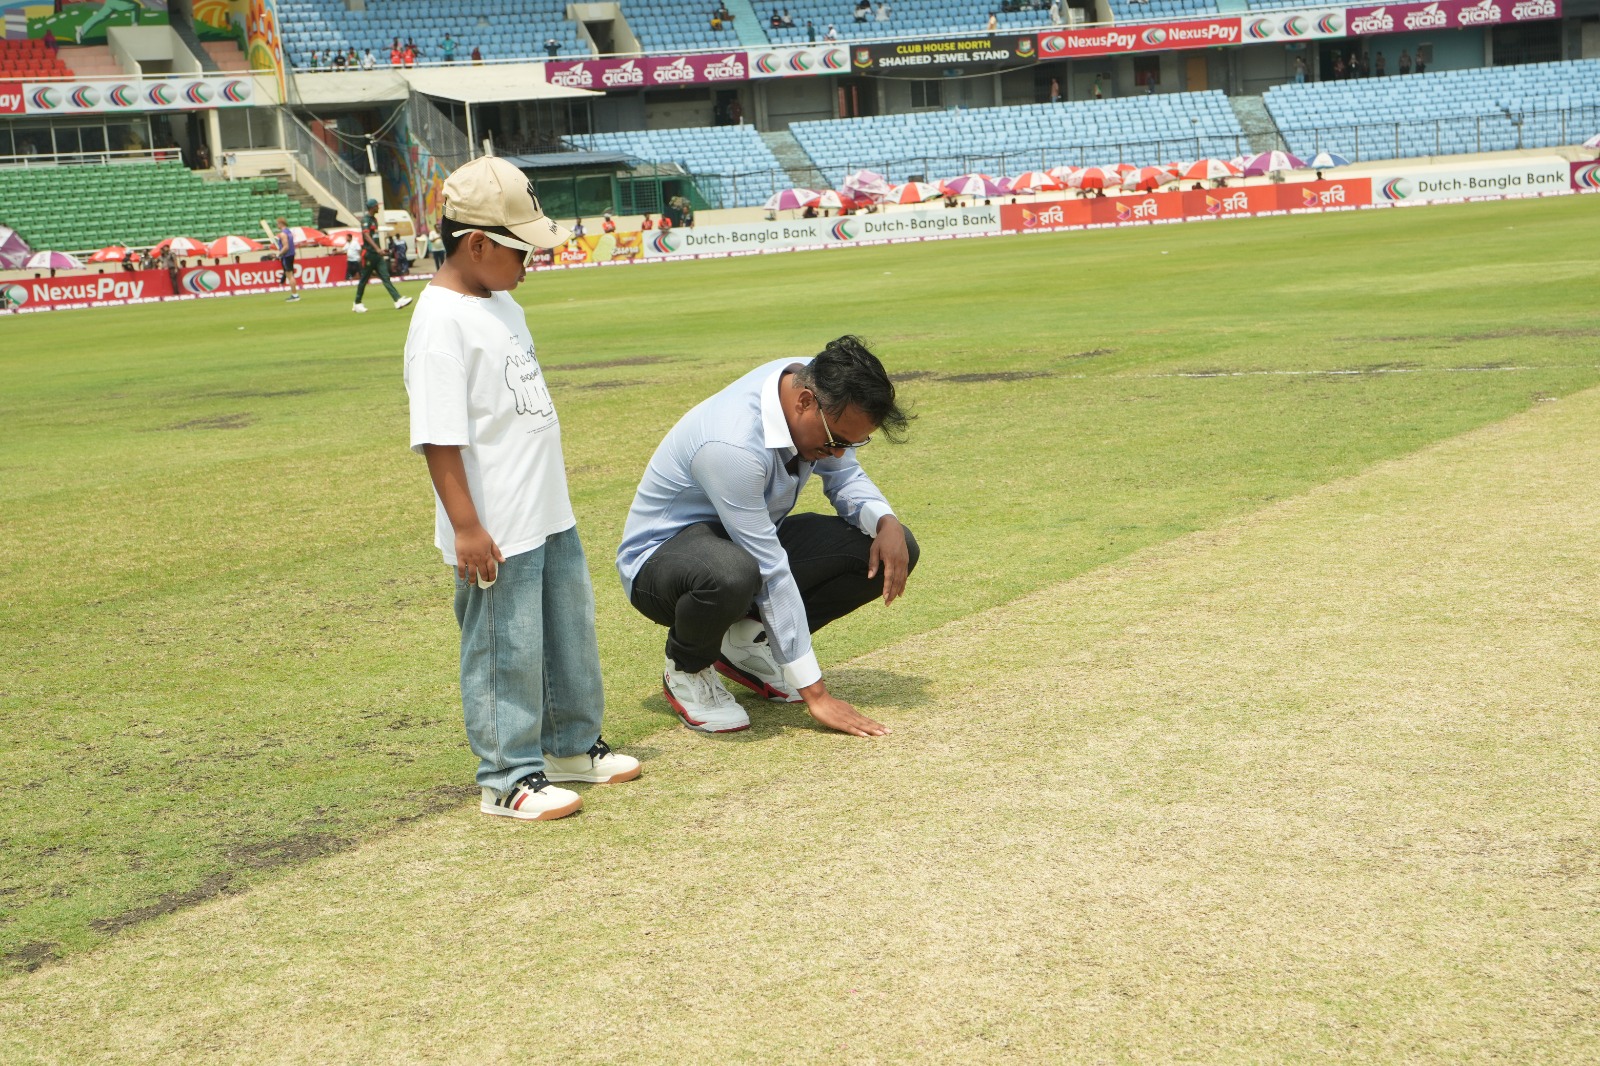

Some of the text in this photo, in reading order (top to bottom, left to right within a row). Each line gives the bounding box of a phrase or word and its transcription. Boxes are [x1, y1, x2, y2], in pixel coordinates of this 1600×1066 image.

[1068, 32, 1136, 49] NexusPay
[1169, 24, 1238, 41] NexusPay
[897, 40, 991, 54] CLUB HOUSE NORTH
[879, 49, 1010, 67] SHAHEED JEWEL STAND
[1418, 175, 1521, 193] Dutch-Bangla
[1527, 171, 1565, 185] Bank
[1223, 192, 1248, 212] রবি
[1320, 184, 1345, 205] রবি
[1039, 205, 1064, 225] রবি
[1133, 198, 1158, 218] রবি
[865, 213, 997, 233] Dutch-Bangla Bank
[686, 226, 817, 246] Dutch-Bangla Bank
[561, 252, 586, 261] Polar
[33, 278, 144, 299] NexusPay
